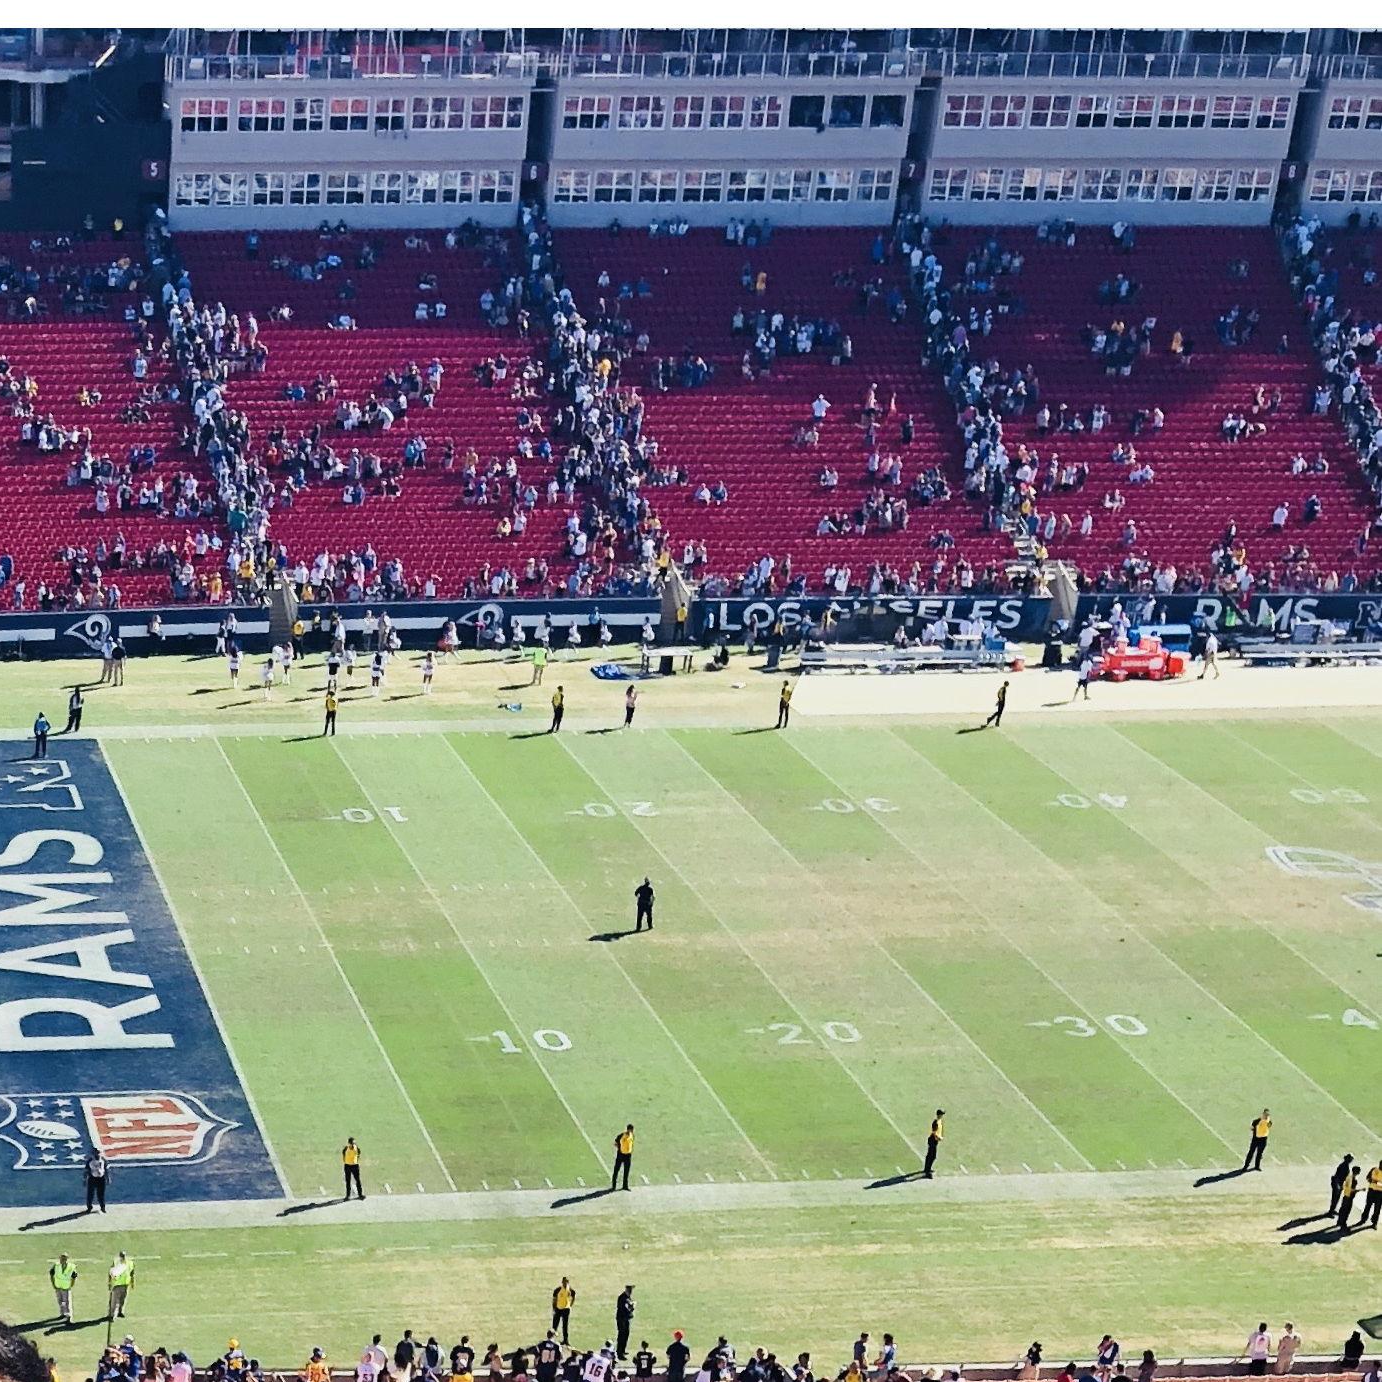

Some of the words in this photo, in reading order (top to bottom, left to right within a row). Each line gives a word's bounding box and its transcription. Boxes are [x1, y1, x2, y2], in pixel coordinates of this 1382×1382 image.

[764, 1020, 863, 1046] 20
[1053, 1014, 1150, 1038] 30
[488, 1028, 573, 1054] 10
[589, 1363, 604, 1378] 16
